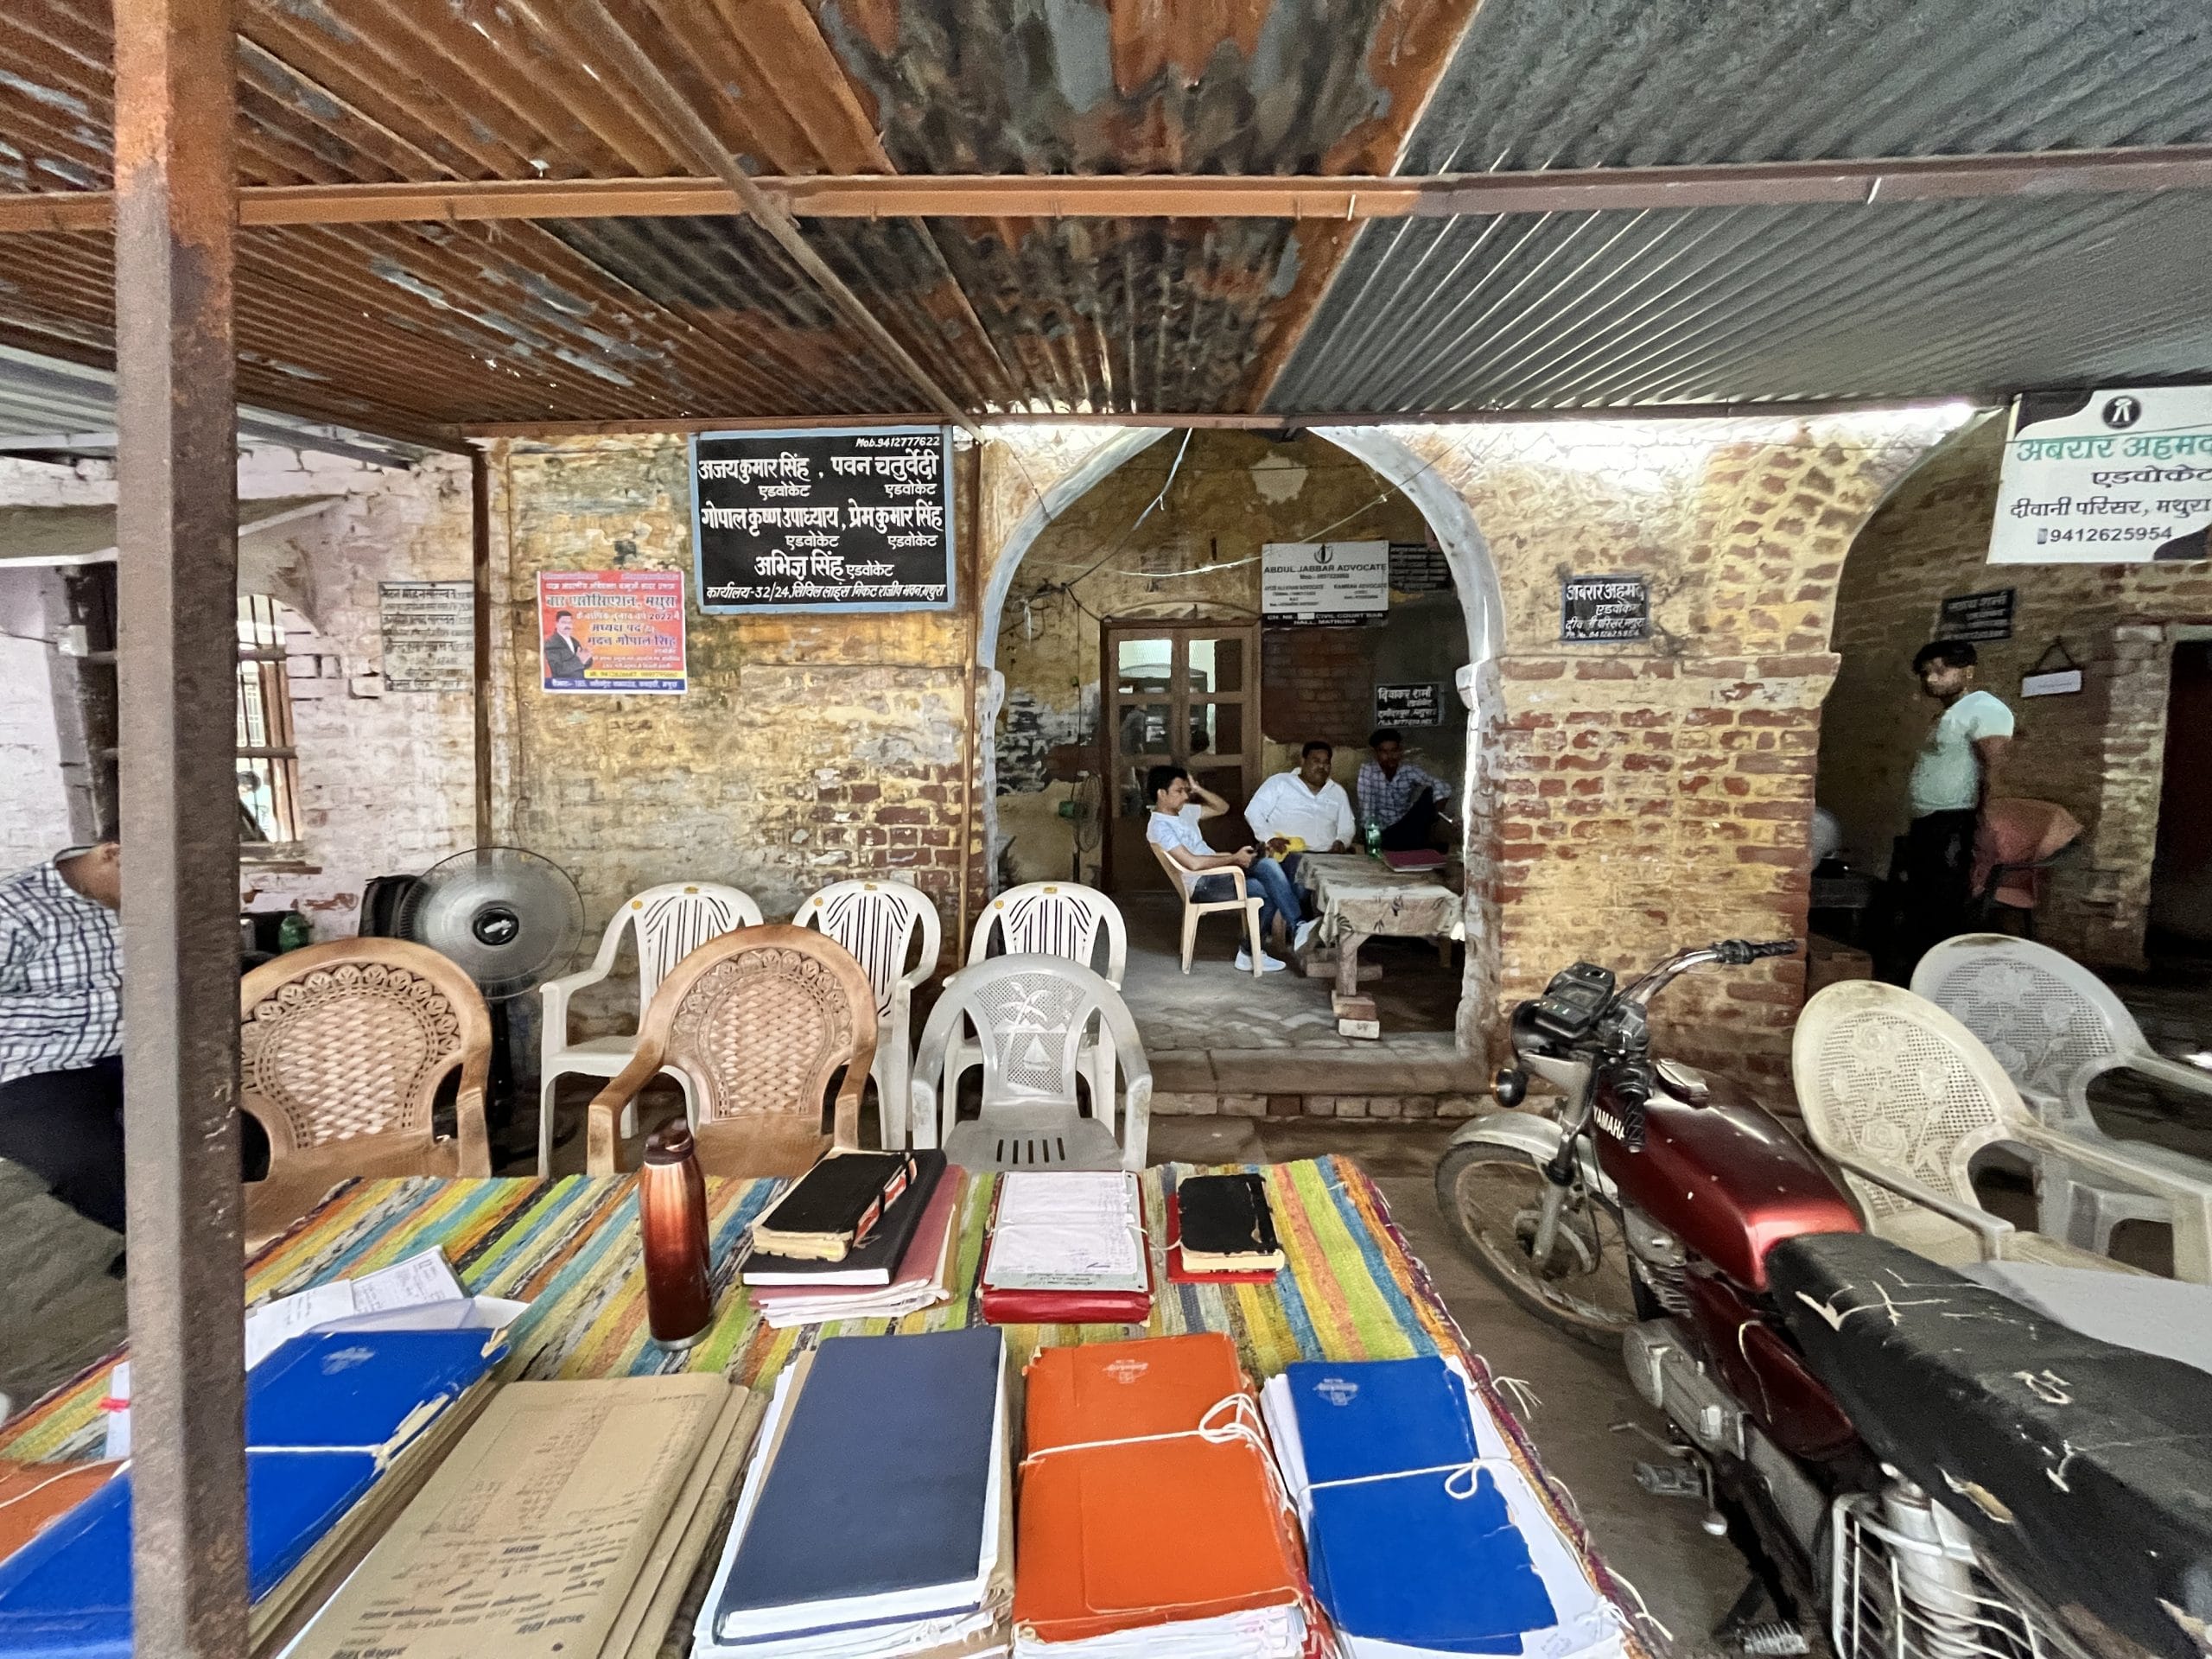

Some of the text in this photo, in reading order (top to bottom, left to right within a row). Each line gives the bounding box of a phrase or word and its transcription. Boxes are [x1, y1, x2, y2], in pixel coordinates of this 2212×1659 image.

[2017, 436, 2115, 461] अबरार
[697, 448, 939, 484] अजय कुमार सिंह पवन चतुर्वेदी
[2091, 464, 2212, 488] एडवोकेट
[758, 480, 811, 500] एडवोकेट
[884, 479, 938, 499] एडवोकेट
[701, 500, 748, 530] गोपाल
[747, 507, 782, 537] कृष्ण
[848, 498, 875, 528] प्रेम
[874, 506, 914, 534] कुमार
[915, 499, 944, 531] सिंह
[2011, 497, 2072, 518] दीवानी
[2155, 498, 2211, 518] मथुरा
[785, 530, 840, 550] एडवोकेट
[887, 531, 938, 550] एडवोकेट
[2050, 526, 2172, 543] 9412625954
[810, 548, 846, 581] सिंह
[845, 560, 895, 579] एडवोकेट
[1566, 584, 1604, 601] अबरार
